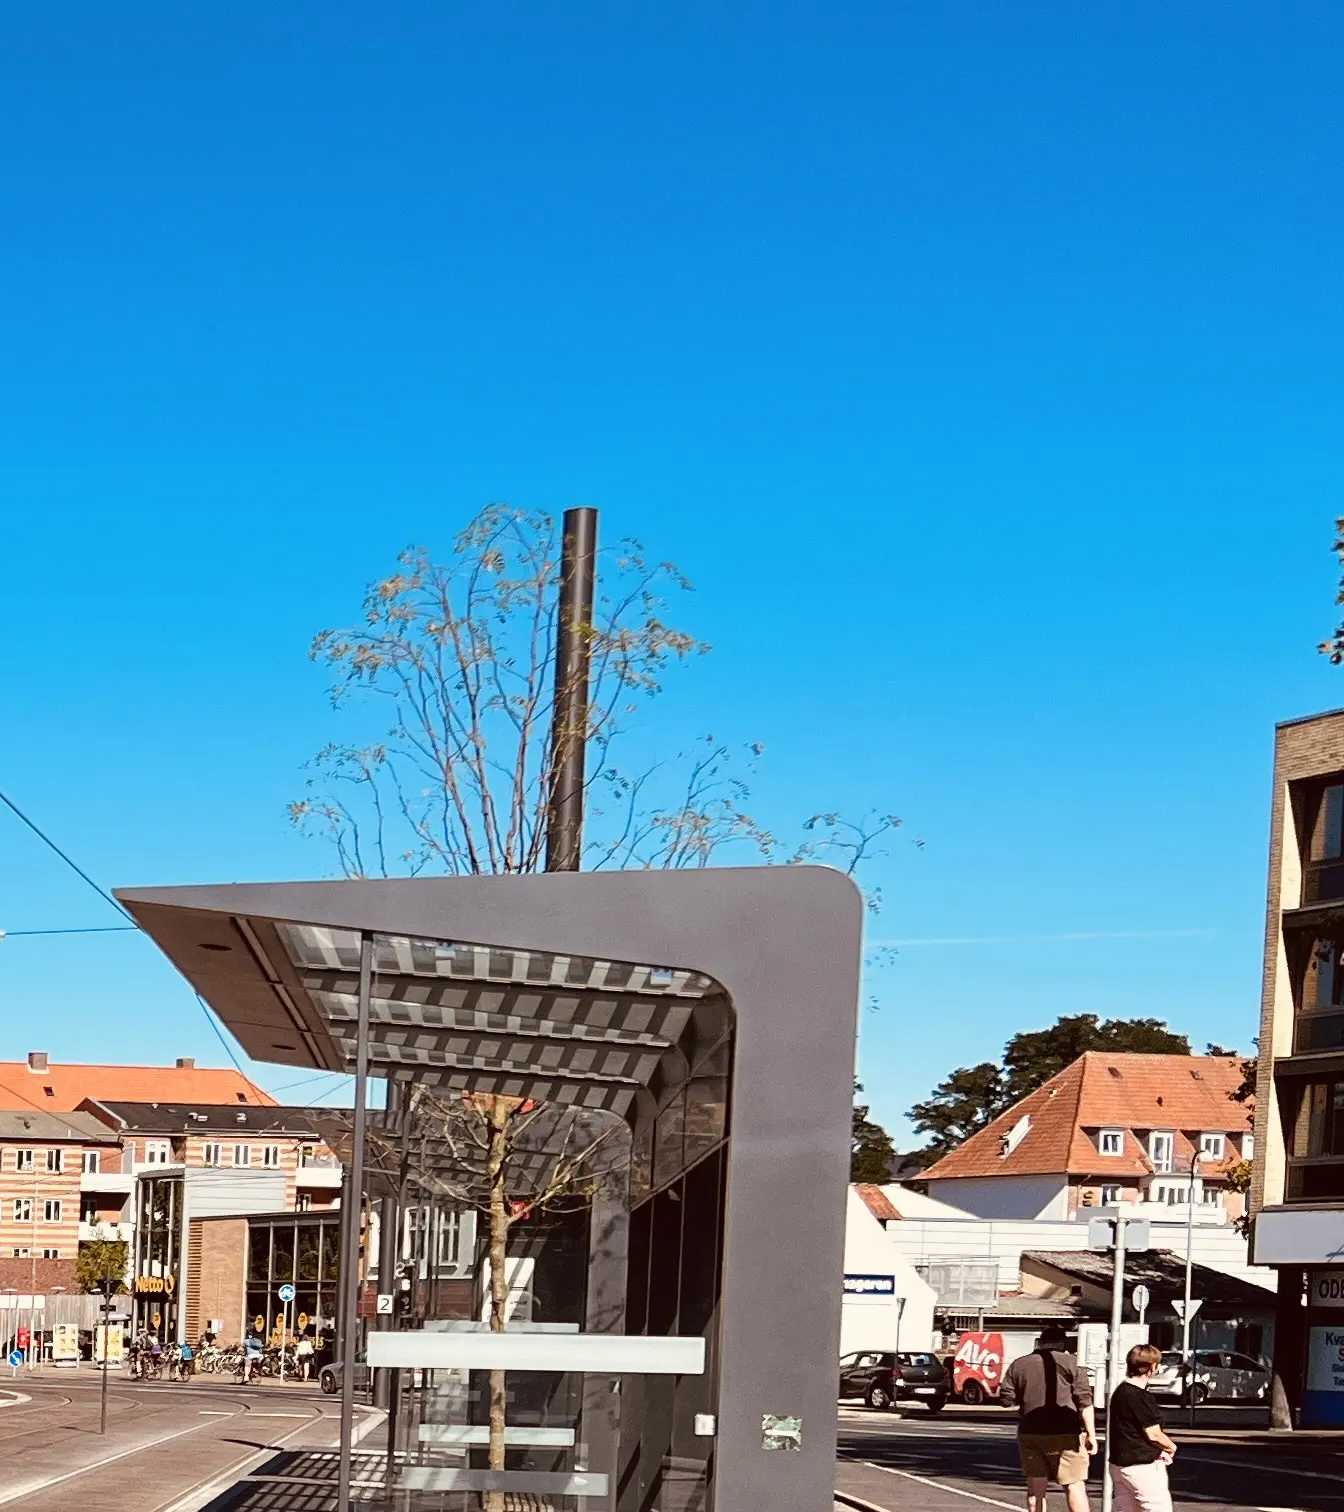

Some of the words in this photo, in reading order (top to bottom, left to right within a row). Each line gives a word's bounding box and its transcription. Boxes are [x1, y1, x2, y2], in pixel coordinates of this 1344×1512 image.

[134, 1275, 164, 1293] Netto
[379, 1297, 390, 1311] 2
[954, 1339, 1001, 1379] AVC
